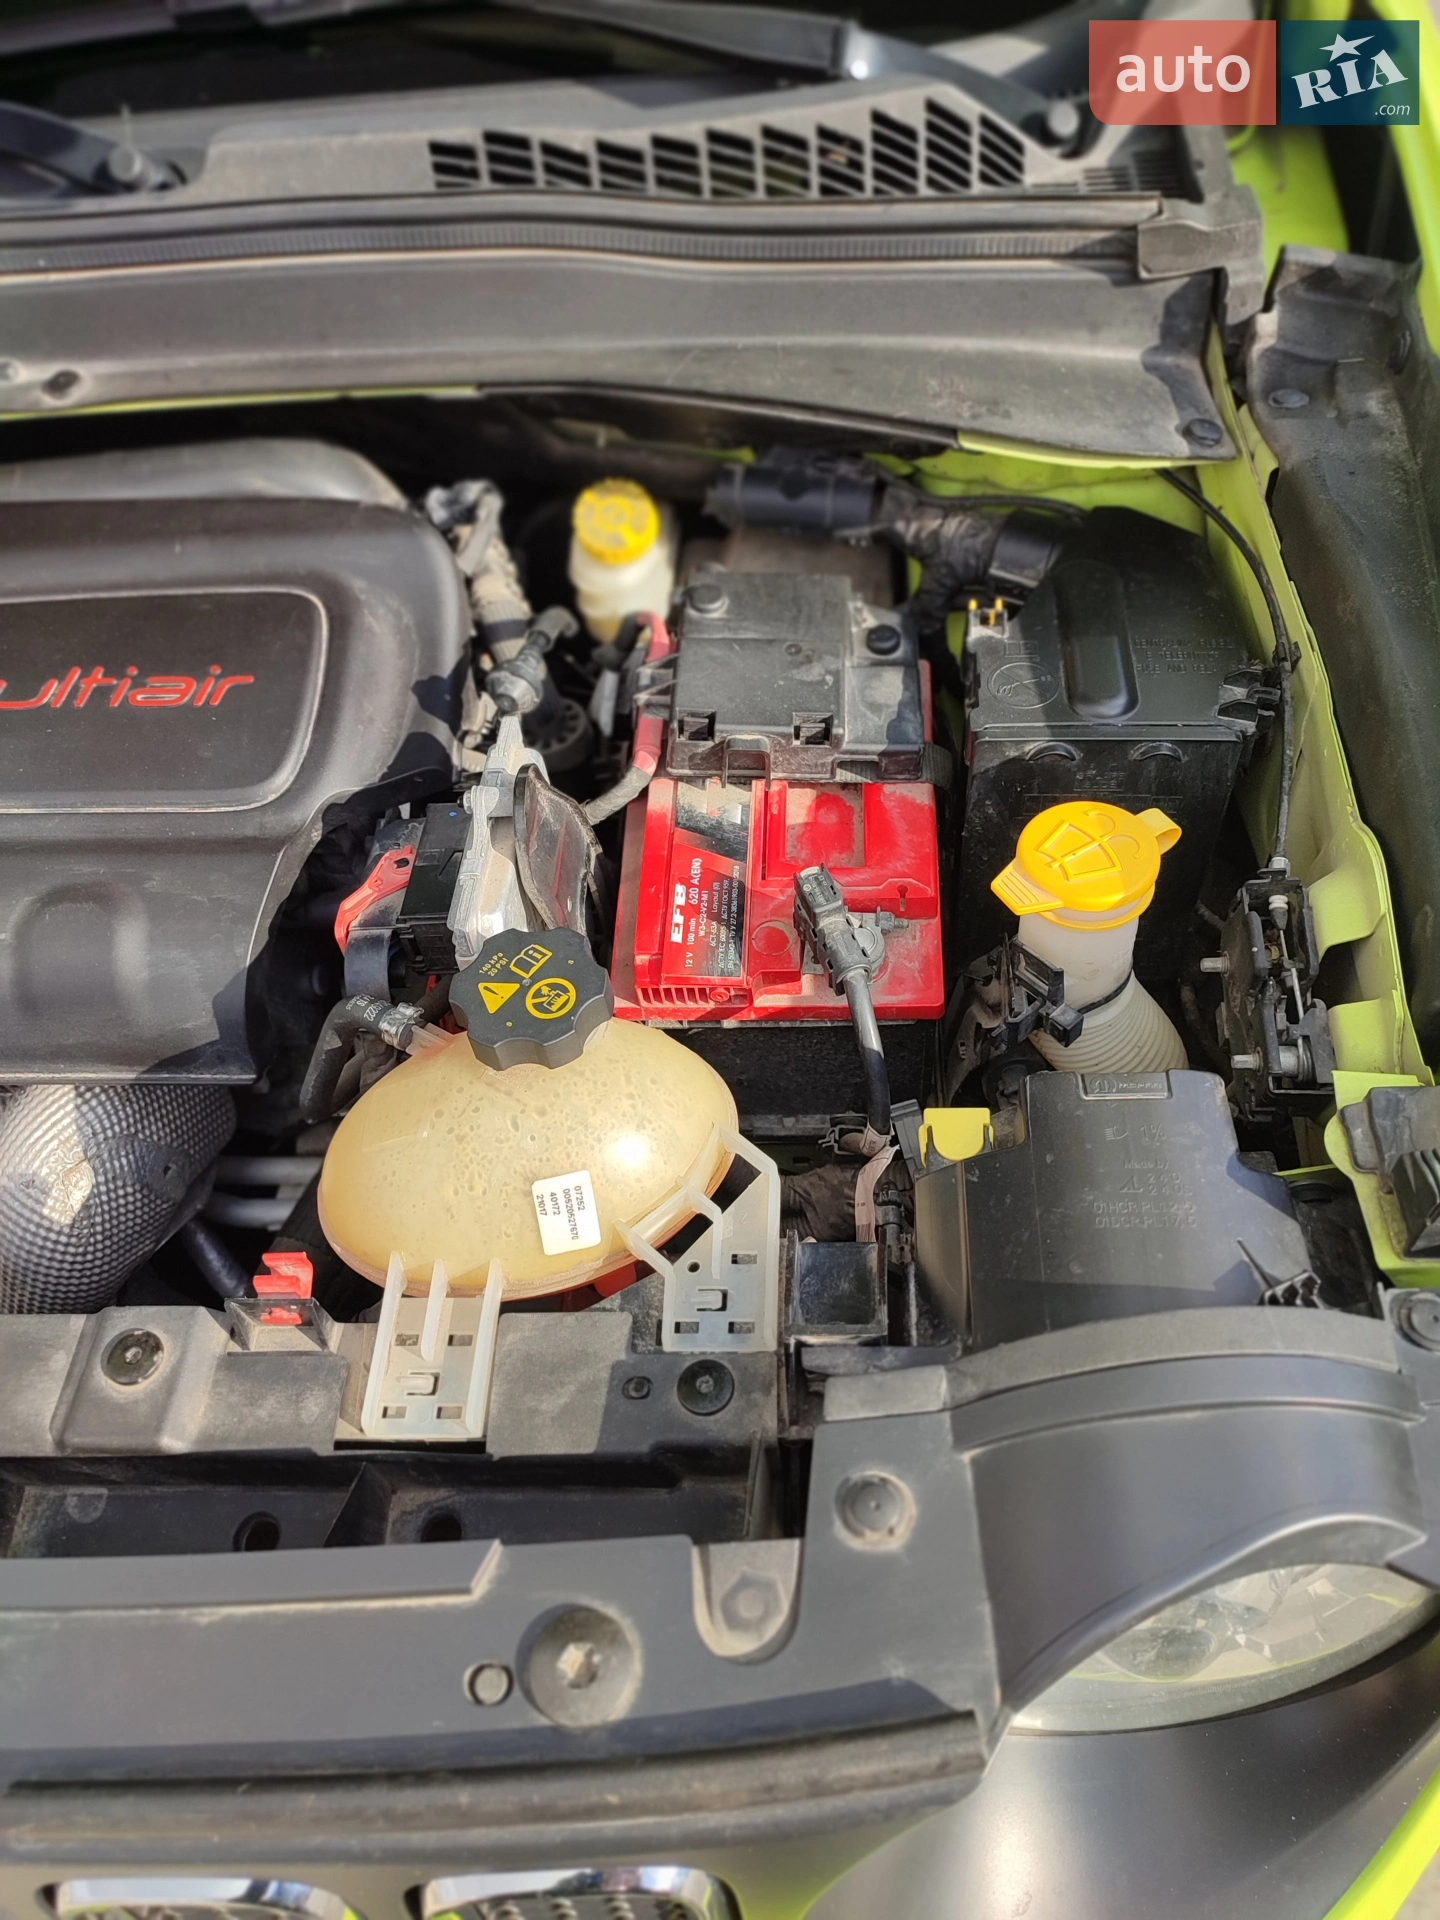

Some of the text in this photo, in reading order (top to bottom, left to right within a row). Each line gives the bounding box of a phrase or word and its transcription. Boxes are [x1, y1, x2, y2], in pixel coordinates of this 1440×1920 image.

[690, 858, 703, 885] A(EN)
[688, 887, 699, 905] 620
[711, 892, 720, 913] Layout
[670, 884, 686, 944] EFB
[698, 890, 709, 937] W3-C2-V2-M1
[687, 918, 696, 932] min
[686, 933, 695, 945] 100
[479, 952, 504, 974] 140 kPa
[488, 957, 509, 977] 20 PSI
[685, 959, 693, 968] 12
[1140, 1122, 1167, 1141] 1%
[536, 1194, 548, 1217] 21017
[550, 1192, 561, 1217] 40172
[574, 1185, 586, 1212] 07252
